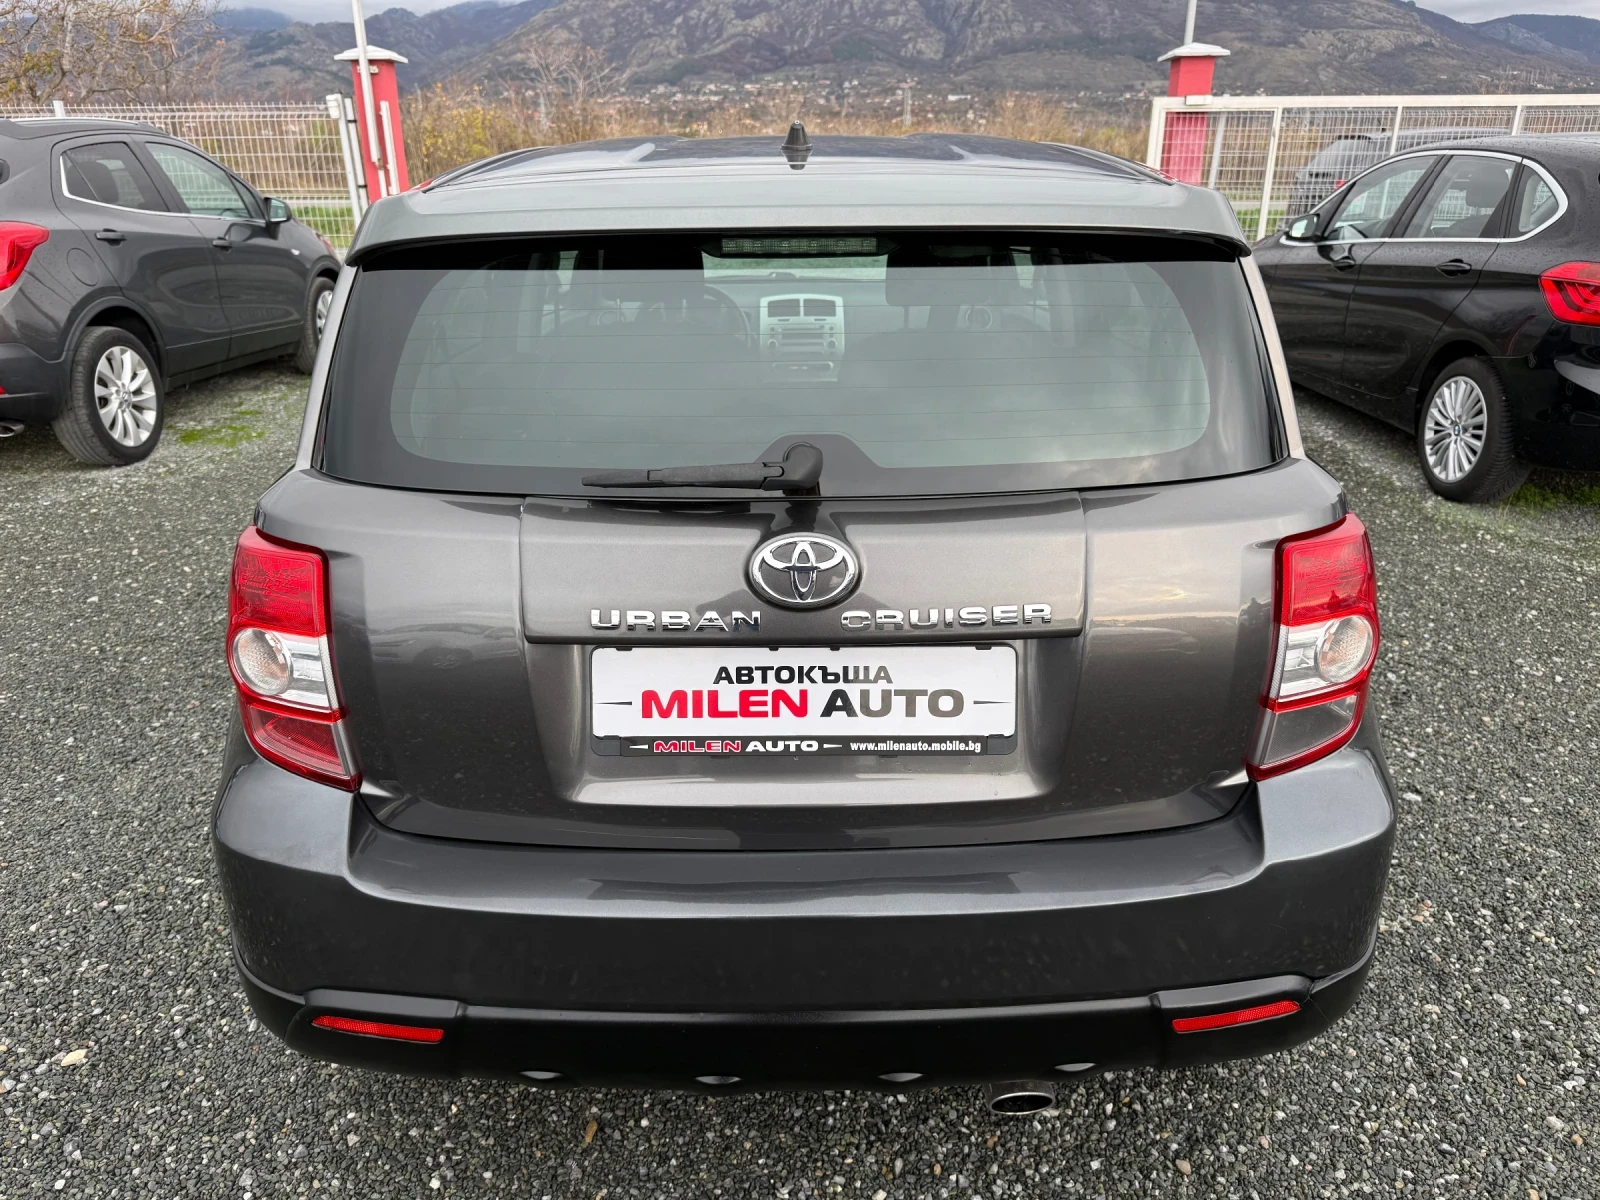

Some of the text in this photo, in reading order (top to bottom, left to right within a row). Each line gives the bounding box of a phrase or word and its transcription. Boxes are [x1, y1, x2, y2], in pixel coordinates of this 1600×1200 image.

[590, 603, 1052, 632] URBAN CRUISER
[712, 665, 893, 685] АВТОКЪЩА
[641, 689, 965, 719] MILEN AUTO
[653, 740, 820, 753] MILEN AUTO
[849, 740, 982, 754] www.milenauto.mobile.bg
